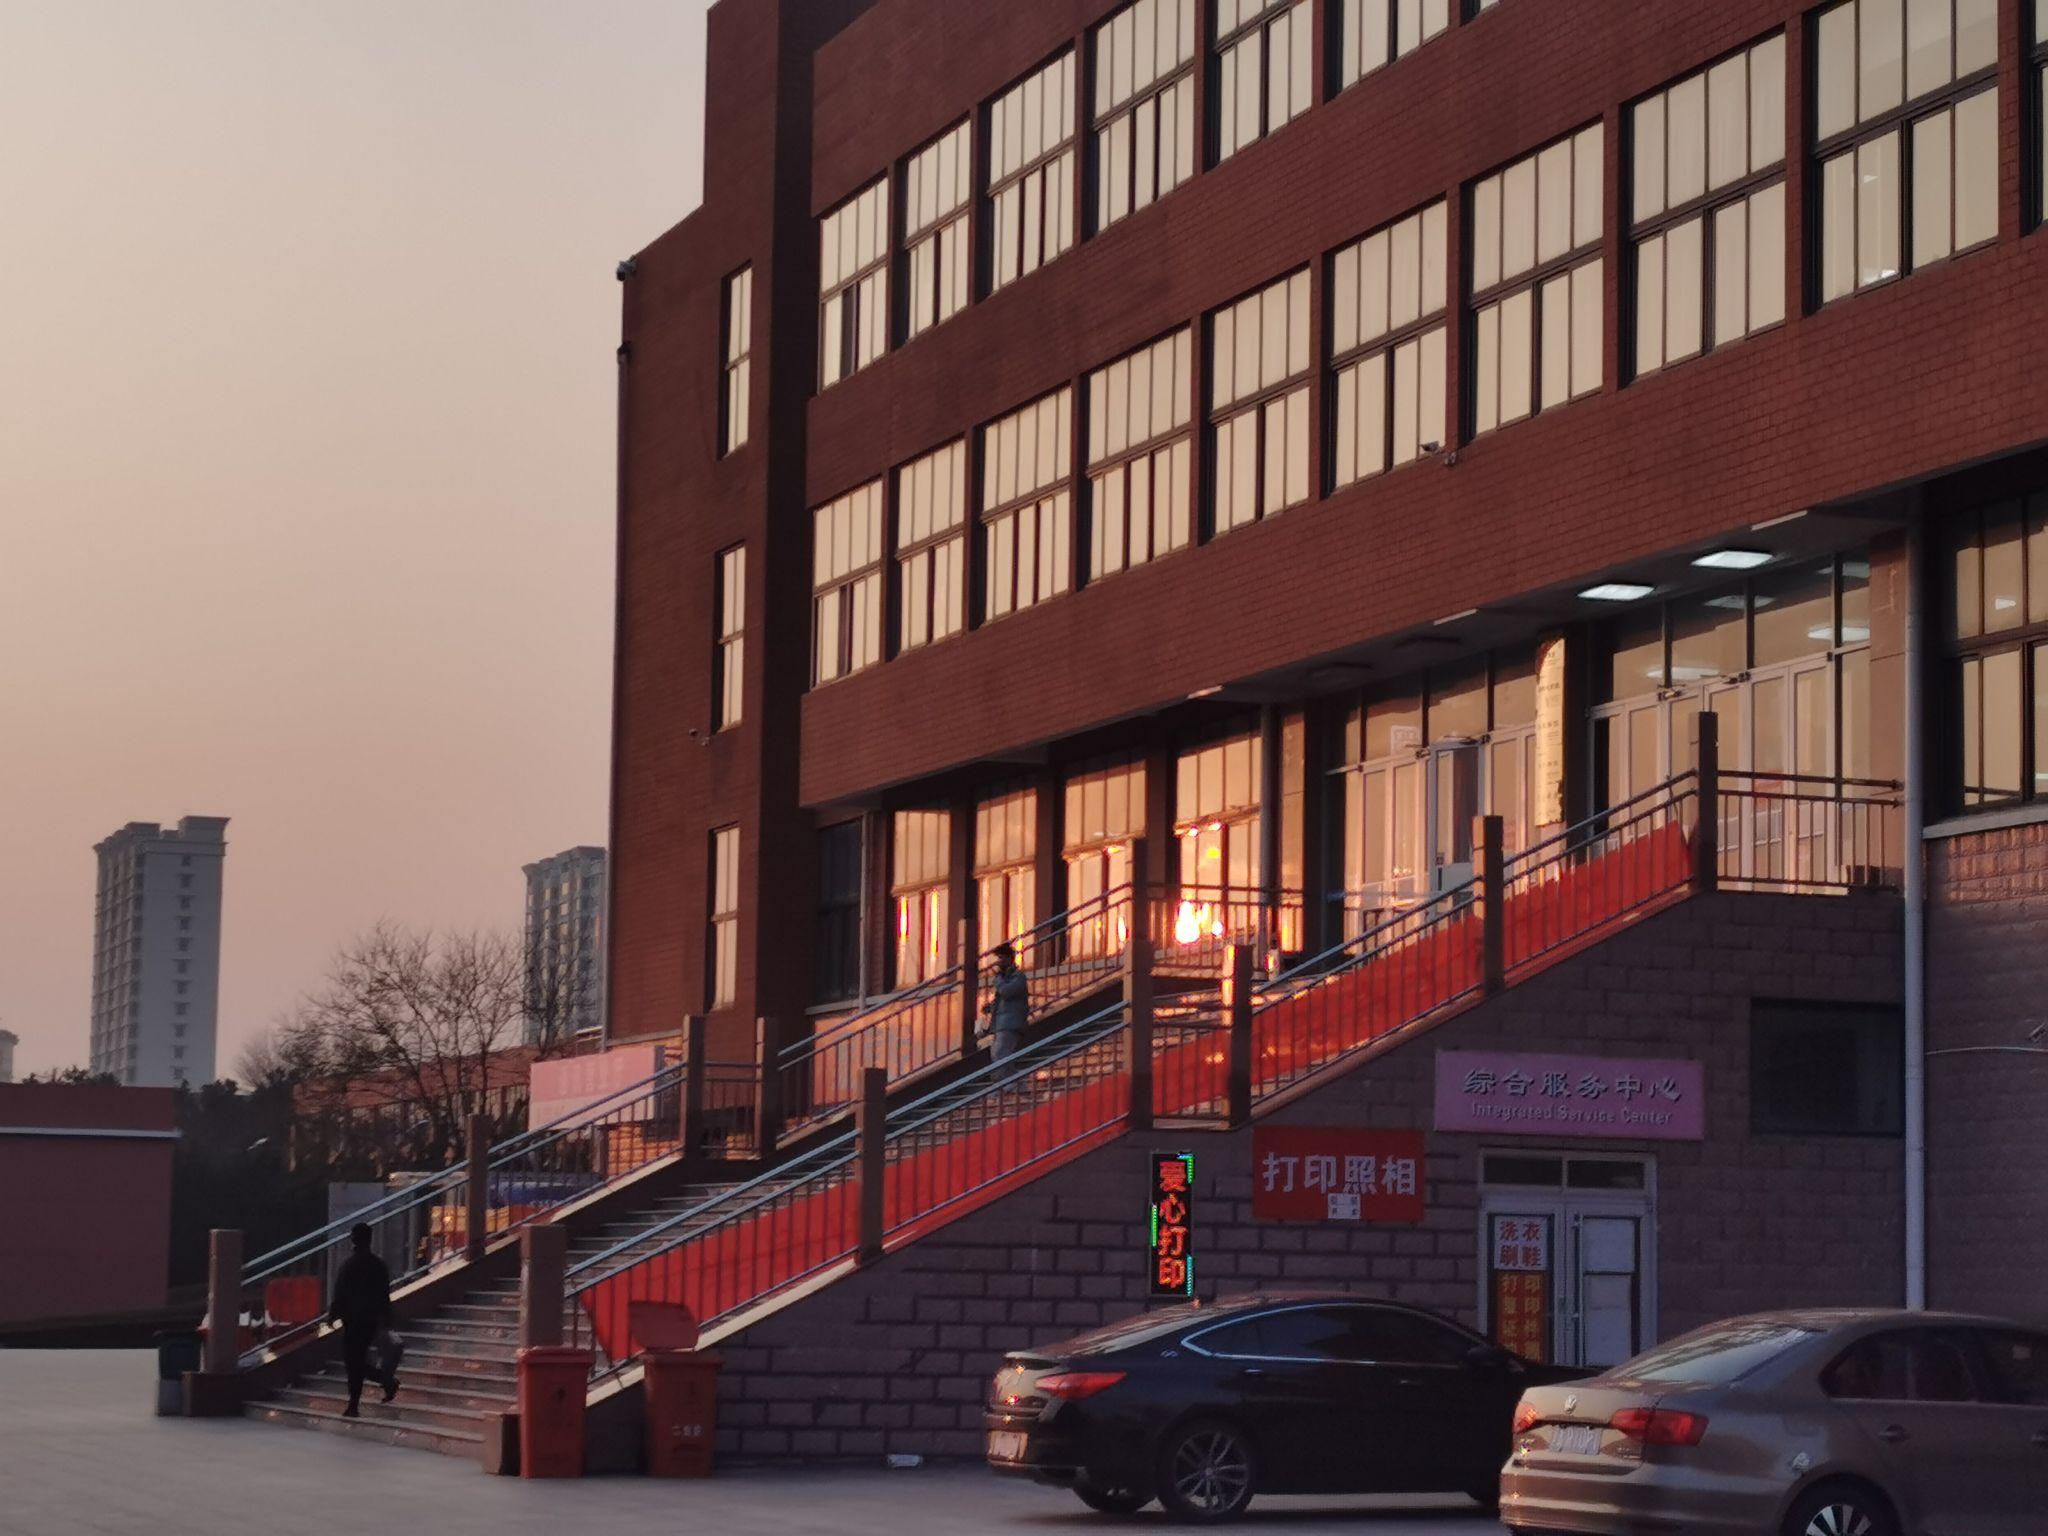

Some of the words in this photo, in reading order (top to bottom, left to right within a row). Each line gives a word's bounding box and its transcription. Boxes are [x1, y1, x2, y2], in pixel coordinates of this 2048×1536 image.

[1463, 1067, 1683, 1102] 综合服务中心
[1471, 1102, 1555, 1122] Integrated
[1558, 1104, 1617, 1123] Service
[1621, 1107, 1674, 1125] Center
[1261, 1152, 1417, 1196] 打印照相
[1157, 1160, 1188, 1290] 爱心打印
[1500, 1219, 1541, 1241] 洗衣
